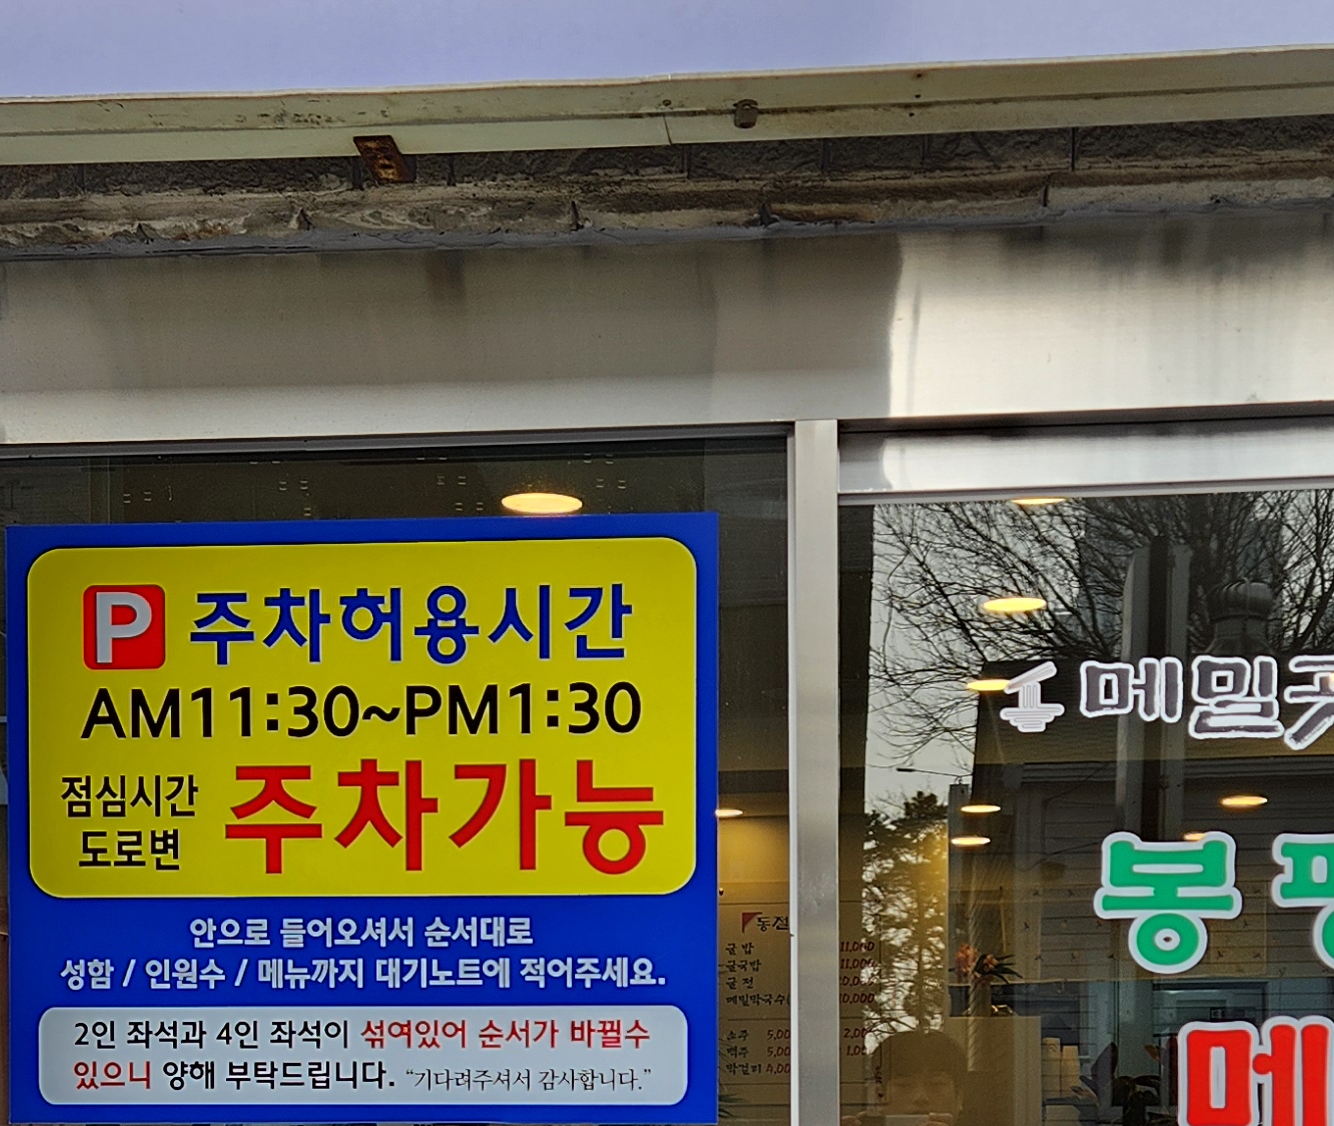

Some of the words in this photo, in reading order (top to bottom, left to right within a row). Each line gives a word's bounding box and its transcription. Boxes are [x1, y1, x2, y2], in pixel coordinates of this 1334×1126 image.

[95, 592, 152, 664] P
[190, 584, 632, 665] 주차허용시간
[81, 682, 641, 738] AM11:30~PM1:30
[61, 775, 198, 817] 점심시간
[225, 759, 663, 875] 주차가능
[79, 829, 179, 870] 도로변
[190, 918, 270, 948] 안으로
[280, 917, 413, 947] 들어오셔서
[425, 917, 533, 947] 순서대로
[61, 959, 114, 990] 성함
[146, 959, 225, 989] 인원수
[259, 958, 363, 989] 메뉴까지
[376, 958, 510, 988] 대기노트에
[520, 957, 665, 988] 적어주세요.
[75, 1021, 115, 1049] 2인
[127, 1021, 206, 1049] 좌석과
[216, 1021, 258, 1048] 4인
[270, 1020, 347, 1048] 좌석이
[361, 1020, 465, 1048] 섞여있어
[479, 1020, 559, 1048] 순서가
[571, 1020, 649, 1048] 바뀔수
[74, 1061, 150, 1089] 있으니
[163, 1061, 214, 1090] 양해
[226, 1061, 394, 1090] 부탁드립니다.
[406, 1069, 530, 1090] “기다려주셔서
[539, 1069, 651, 1091] 감사합니다.”
